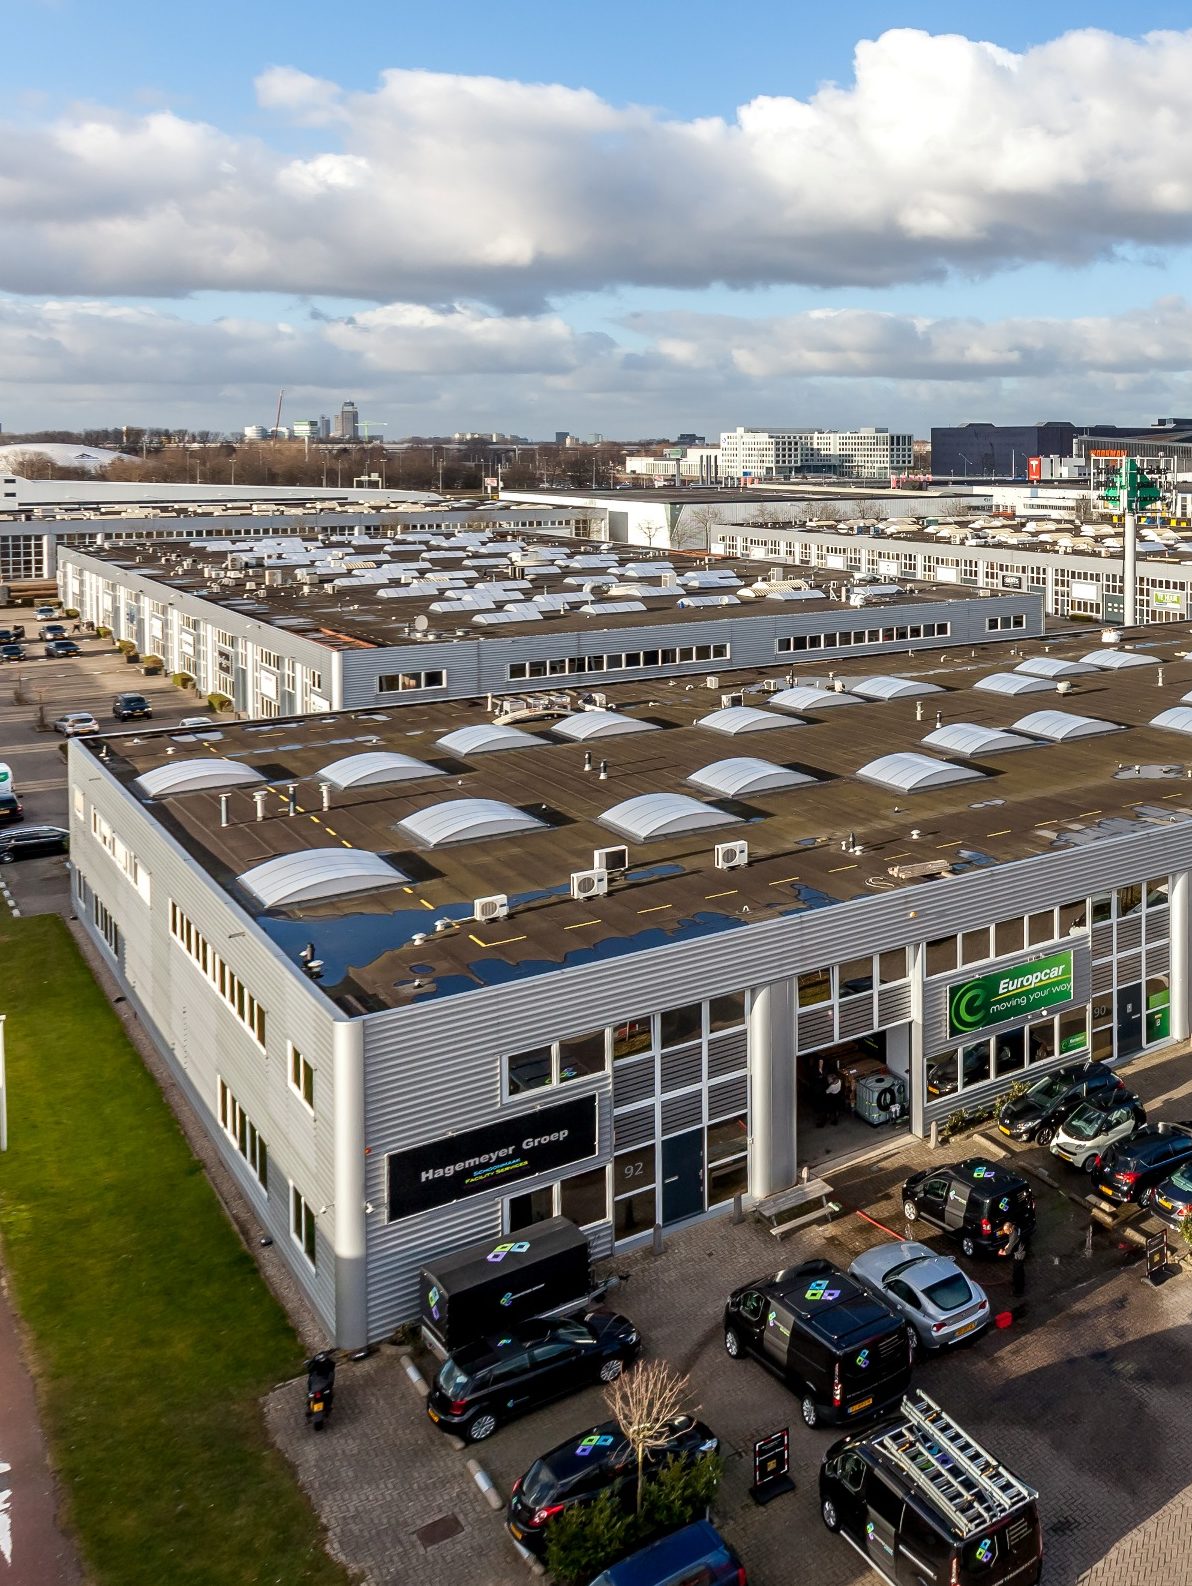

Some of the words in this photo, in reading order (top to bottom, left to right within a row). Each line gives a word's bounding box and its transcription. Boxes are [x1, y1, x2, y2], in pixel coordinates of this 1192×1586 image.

[998, 964, 1065, 995] Europcar
[989, 996, 1027, 1014] moving
[1029, 987, 1051, 1003] your
[1051, 981, 1072, 993] way
[1094, 1006, 1107, 1018] 90
[420, 1145, 516, 1183] Hagemeyer
[522, 1129, 569, 1151] Groep
[624, 1162, 644, 1179] 92
